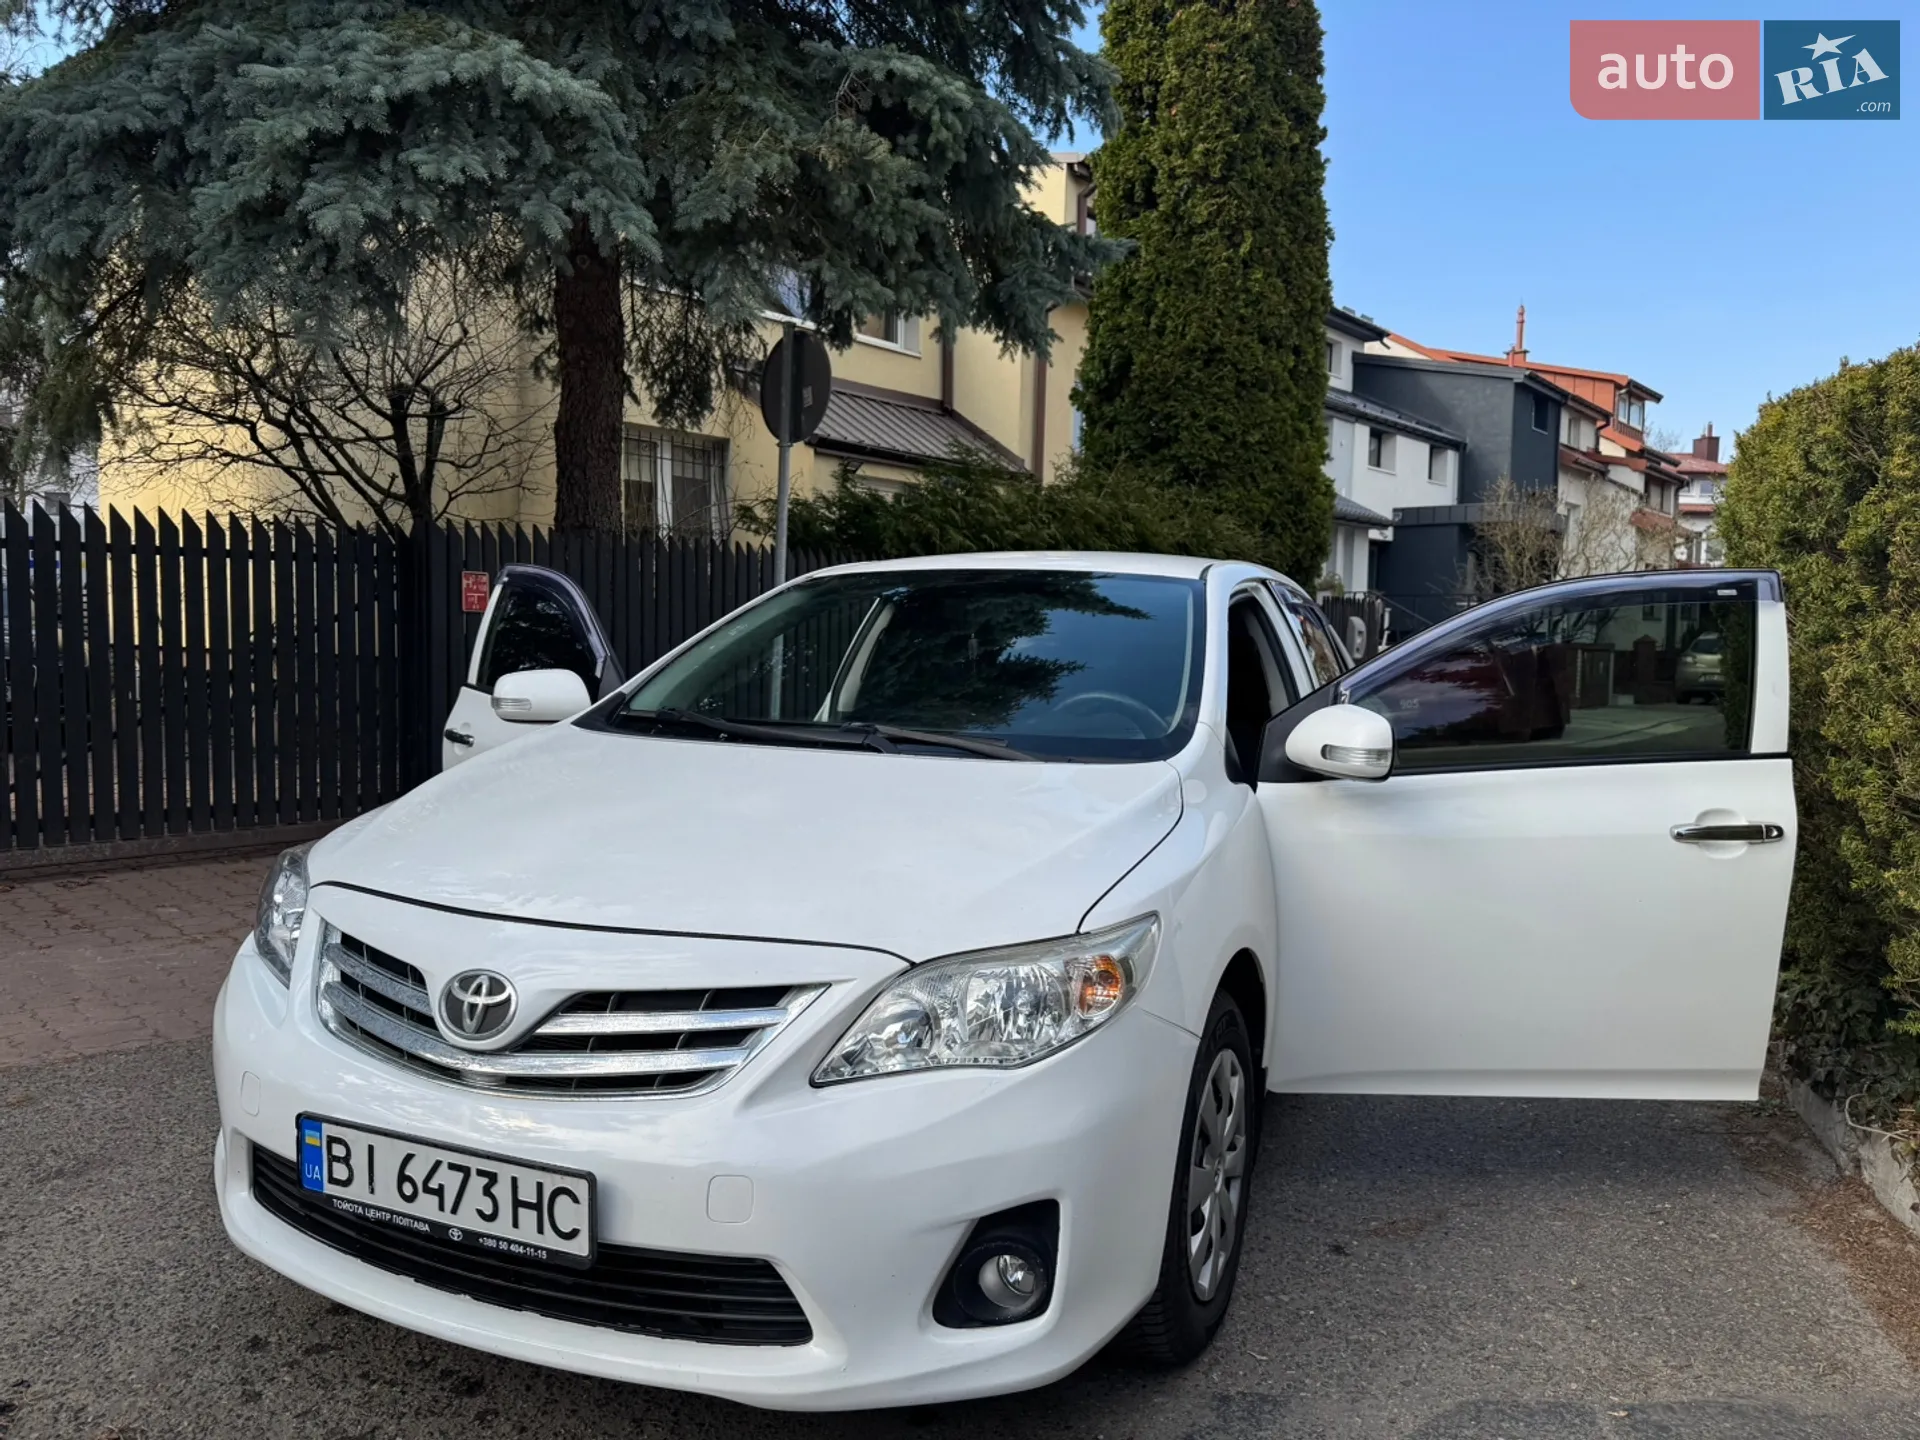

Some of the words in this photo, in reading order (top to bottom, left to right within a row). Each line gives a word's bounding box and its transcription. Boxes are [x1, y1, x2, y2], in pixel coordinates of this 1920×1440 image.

[305, 1163, 321, 1181] UA
[332, 1198, 363, 1214] ТОЙОТА
[365, 1207, 391, 1220] ЦЕНТР
[392, 1214, 430, 1232] ПОЛТАВА
[478, 1237, 497, 1248] +380
[498, 1241, 508, 1250] 50
[509, 1243, 547, 1259] 404-11-15
